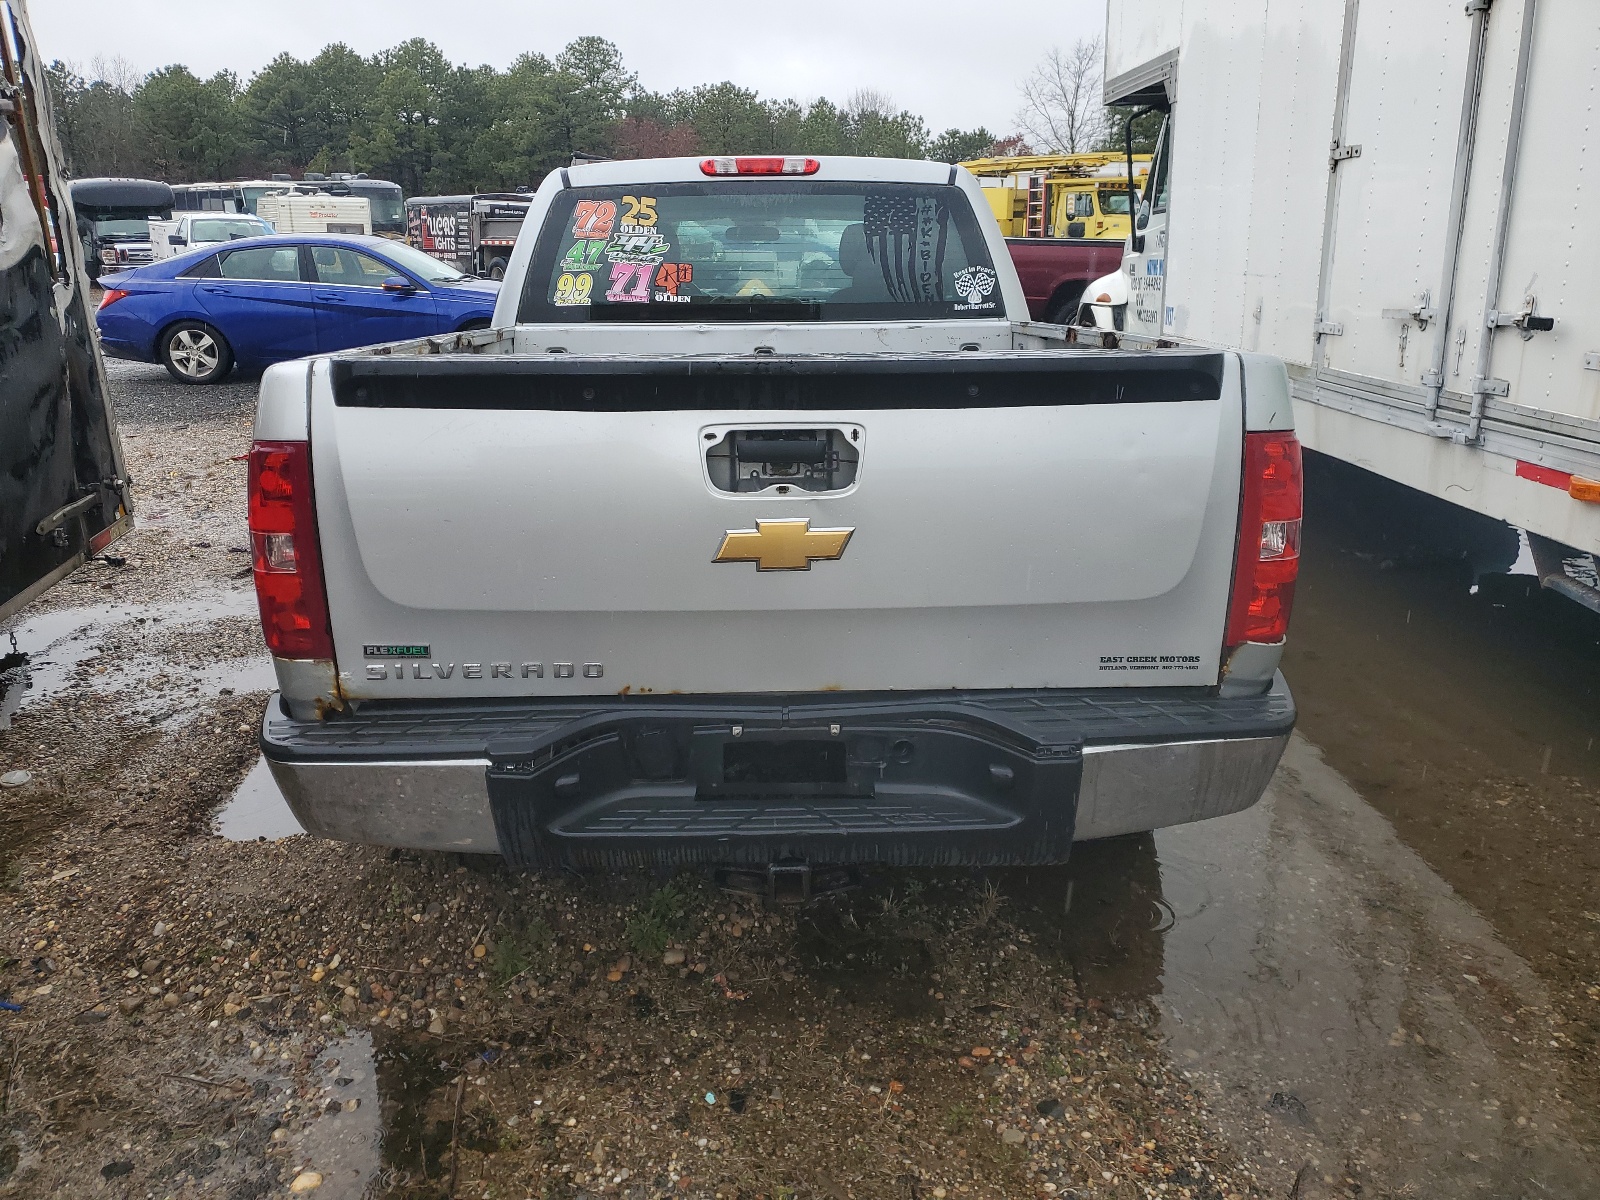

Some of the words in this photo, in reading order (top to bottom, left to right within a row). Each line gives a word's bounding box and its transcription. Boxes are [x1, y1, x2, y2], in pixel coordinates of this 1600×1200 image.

[574, 199, 617, 233] 72
[621, 195, 659, 226] 25
[620, 225, 658, 235] OLDEN
[566, 240, 607, 264] 47
[609, 262, 655, 297] 71
[976, 265, 996, 276] Peace
[556, 272, 593, 299] 99
[655, 295, 692, 303] OLDEN
[365, 661, 604, 681] SILVERADO
